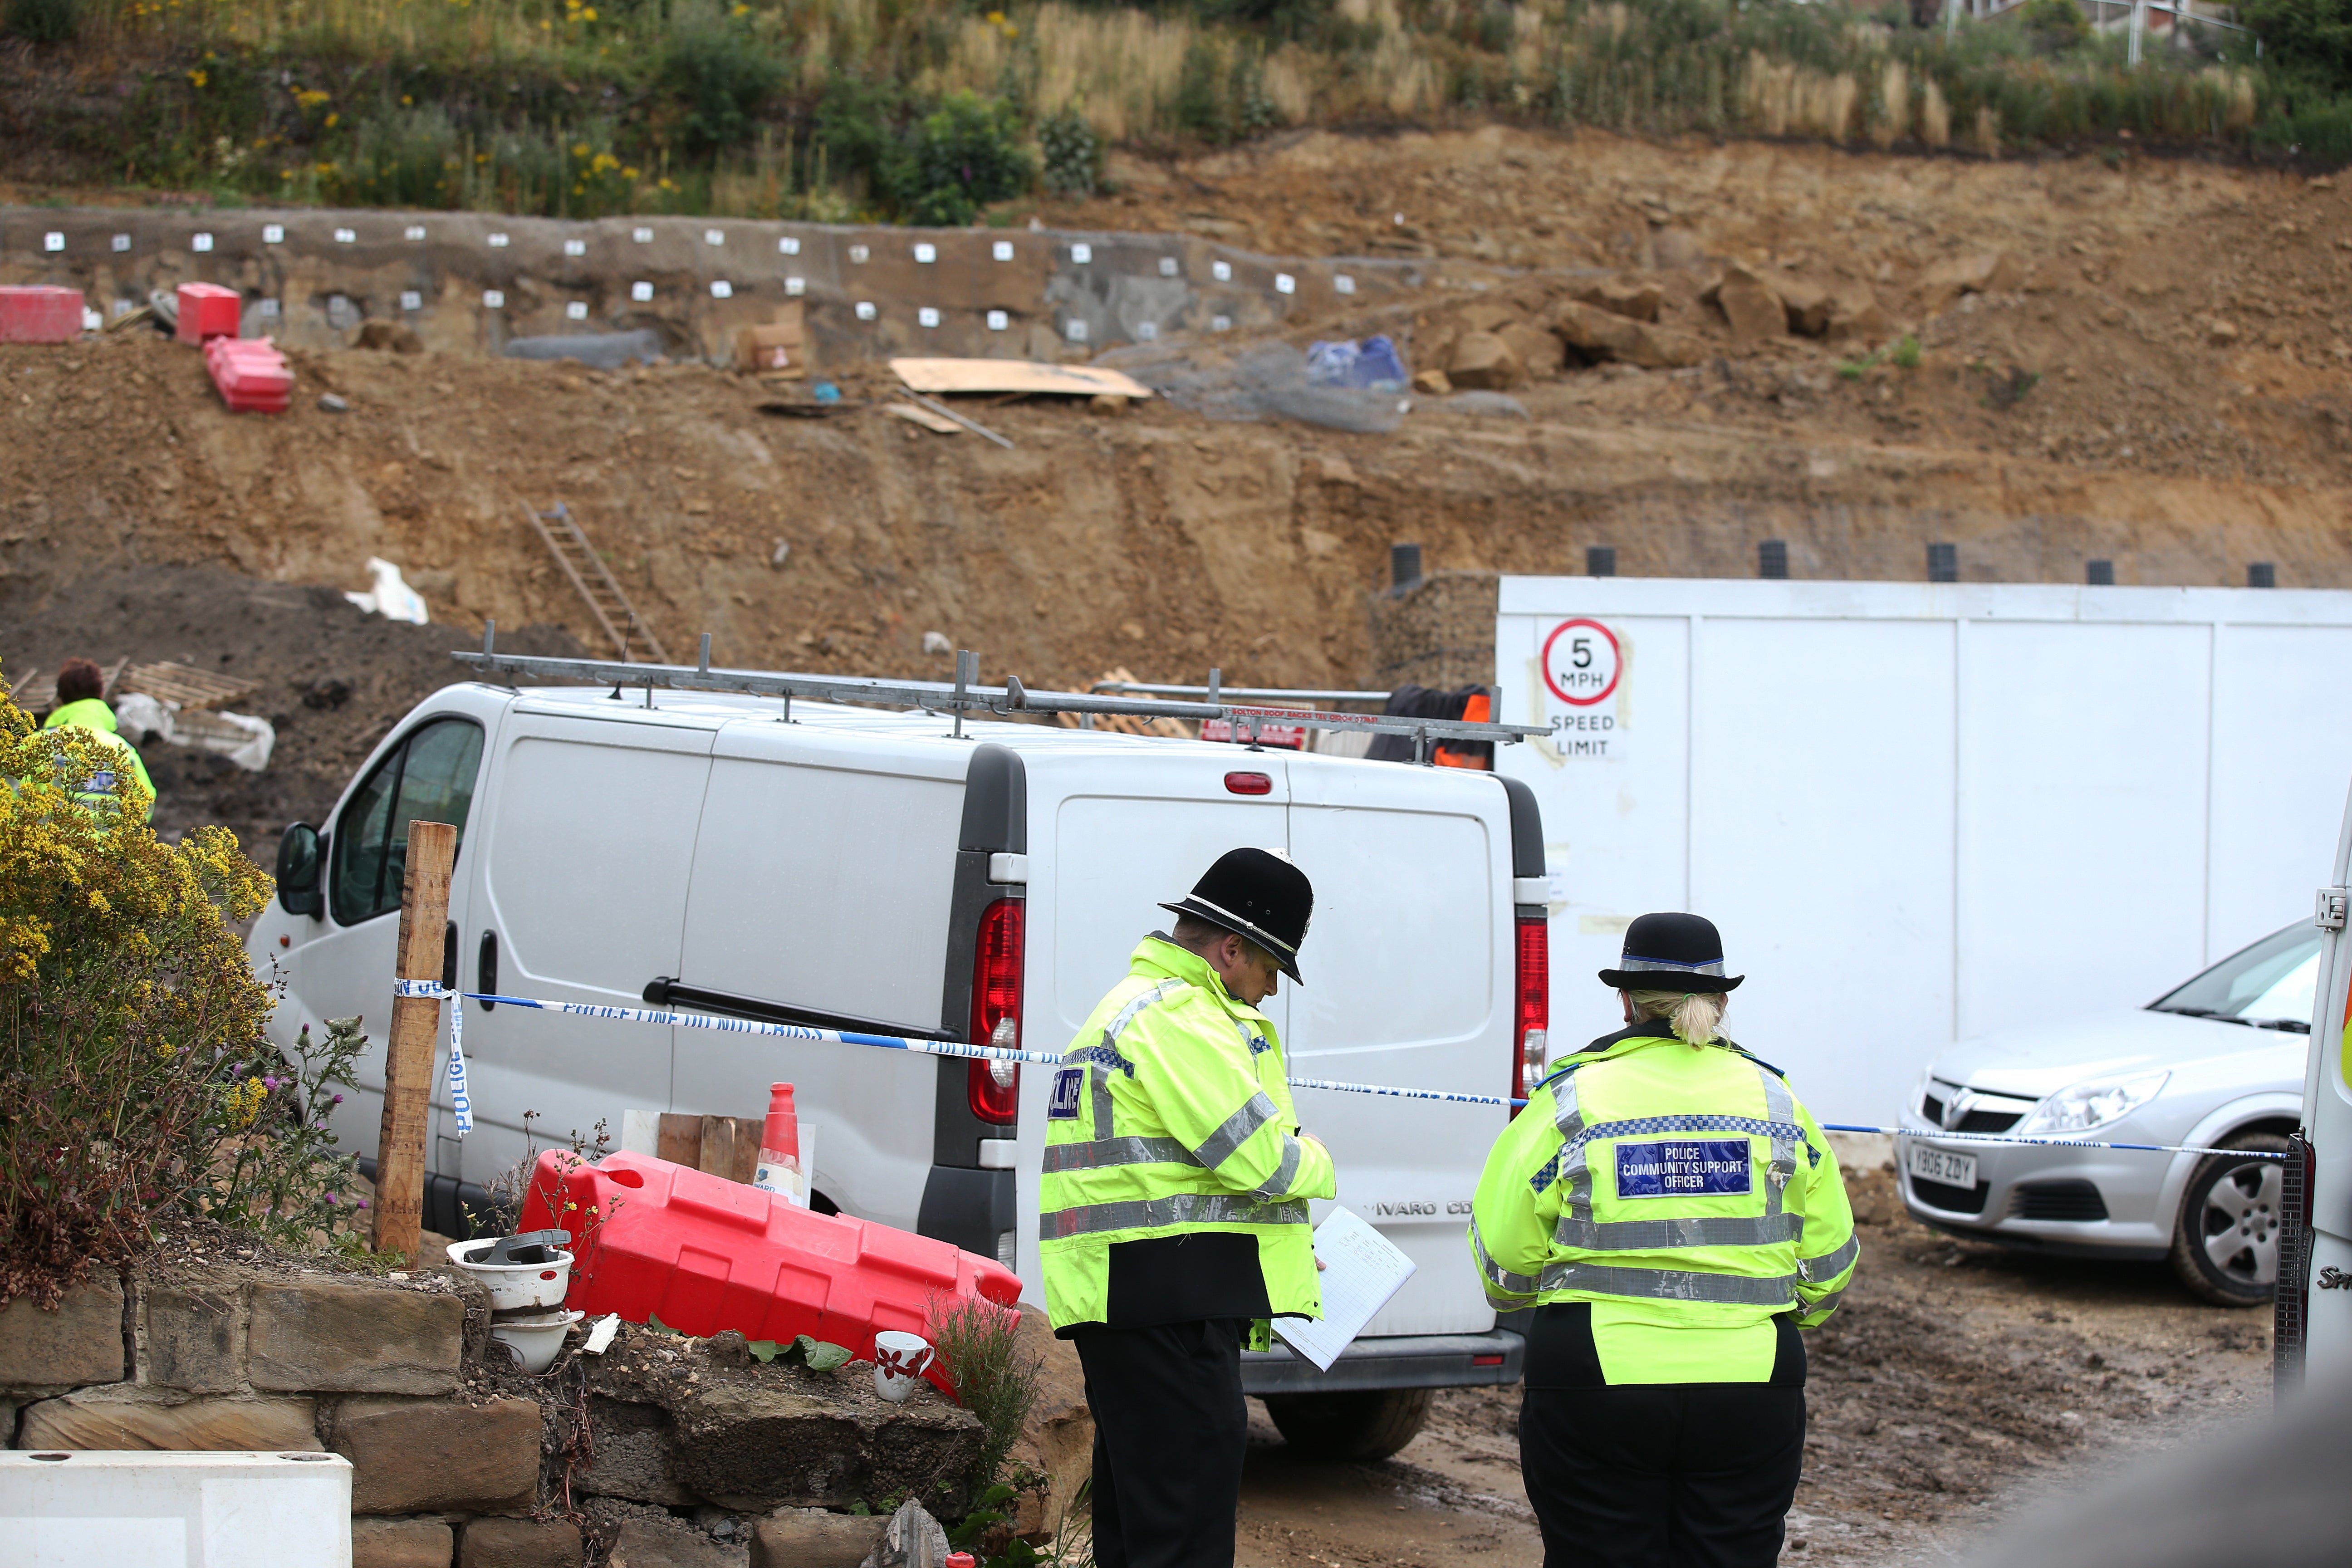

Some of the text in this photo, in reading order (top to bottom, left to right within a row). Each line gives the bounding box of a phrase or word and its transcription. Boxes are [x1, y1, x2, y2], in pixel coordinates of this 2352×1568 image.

[1573, 638, 1592, 668] 5
[1561, 673, 1604, 687] MPH
[1551, 715, 1614, 731] SPEED
[1557, 740, 1609, 755] LIMIT
[926, 1040, 989, 1058] POLICE
[1049, 1077, 1080, 1110] OLICE
[1665, 1147, 1700, 1160] POLICE
[1623, 1161, 1743, 1176] COMMUNITY SUPPORT
[1665, 1175, 1704, 1188] OFFICER
